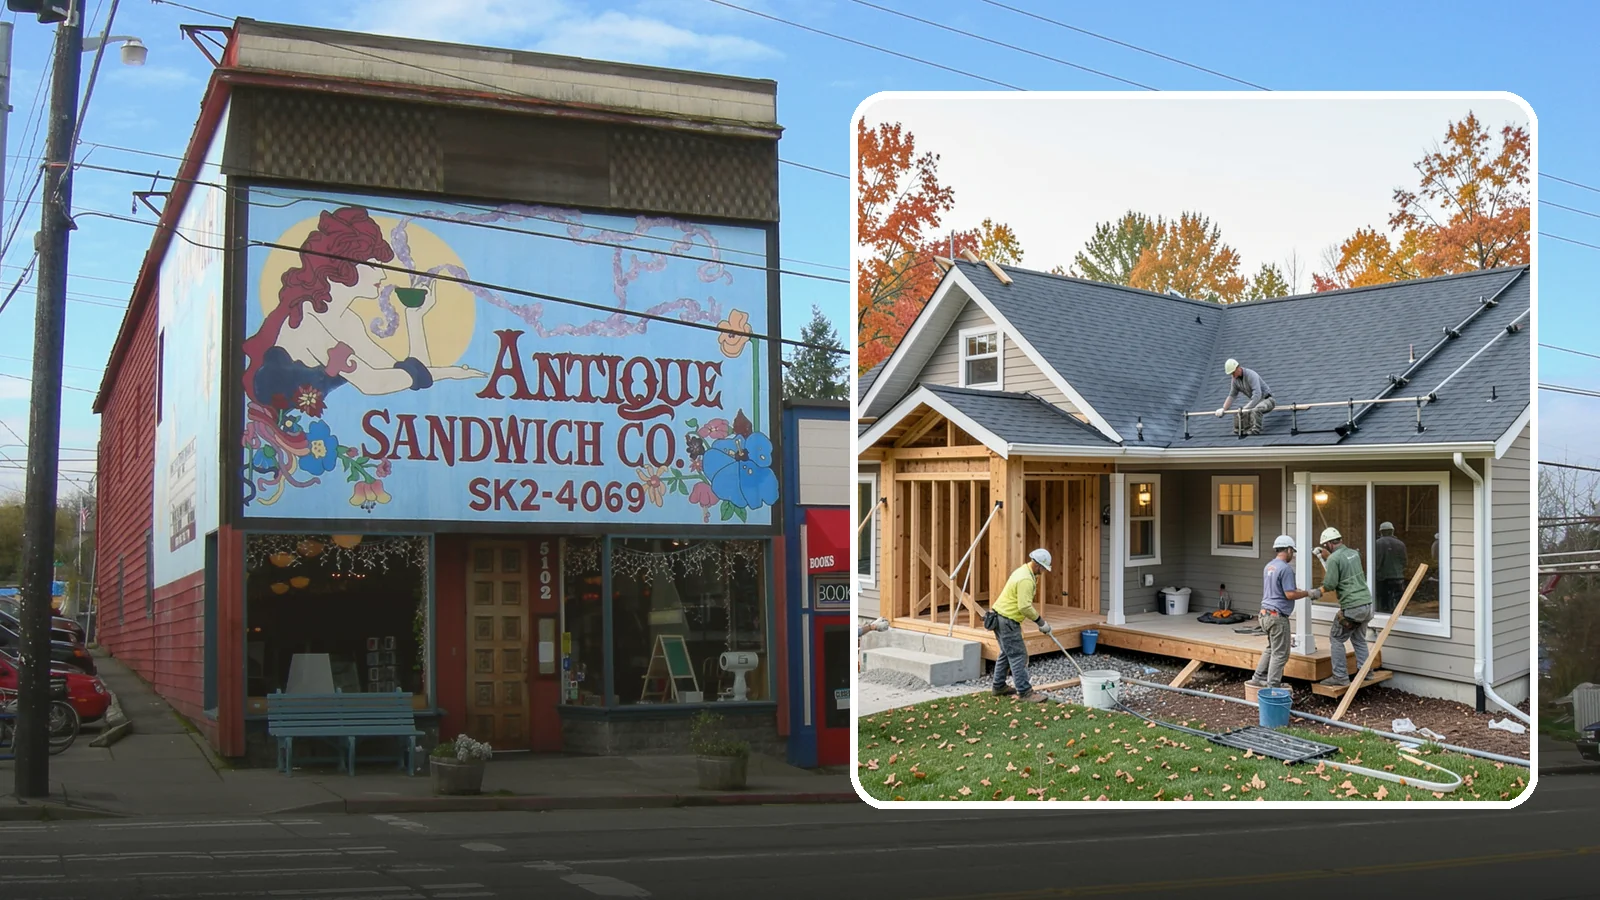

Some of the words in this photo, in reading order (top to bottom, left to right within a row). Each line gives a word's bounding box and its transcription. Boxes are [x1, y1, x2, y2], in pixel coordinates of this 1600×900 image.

[475, 328, 724, 421] ANTIQUE
[361, 408, 605, 467] SANDWICH
[616, 421, 685, 469] CO.
[468, 476, 645, 513] SK2-4069
[540, 541, 551, 600] 5102
[809, 555, 835, 569] BOOKS
